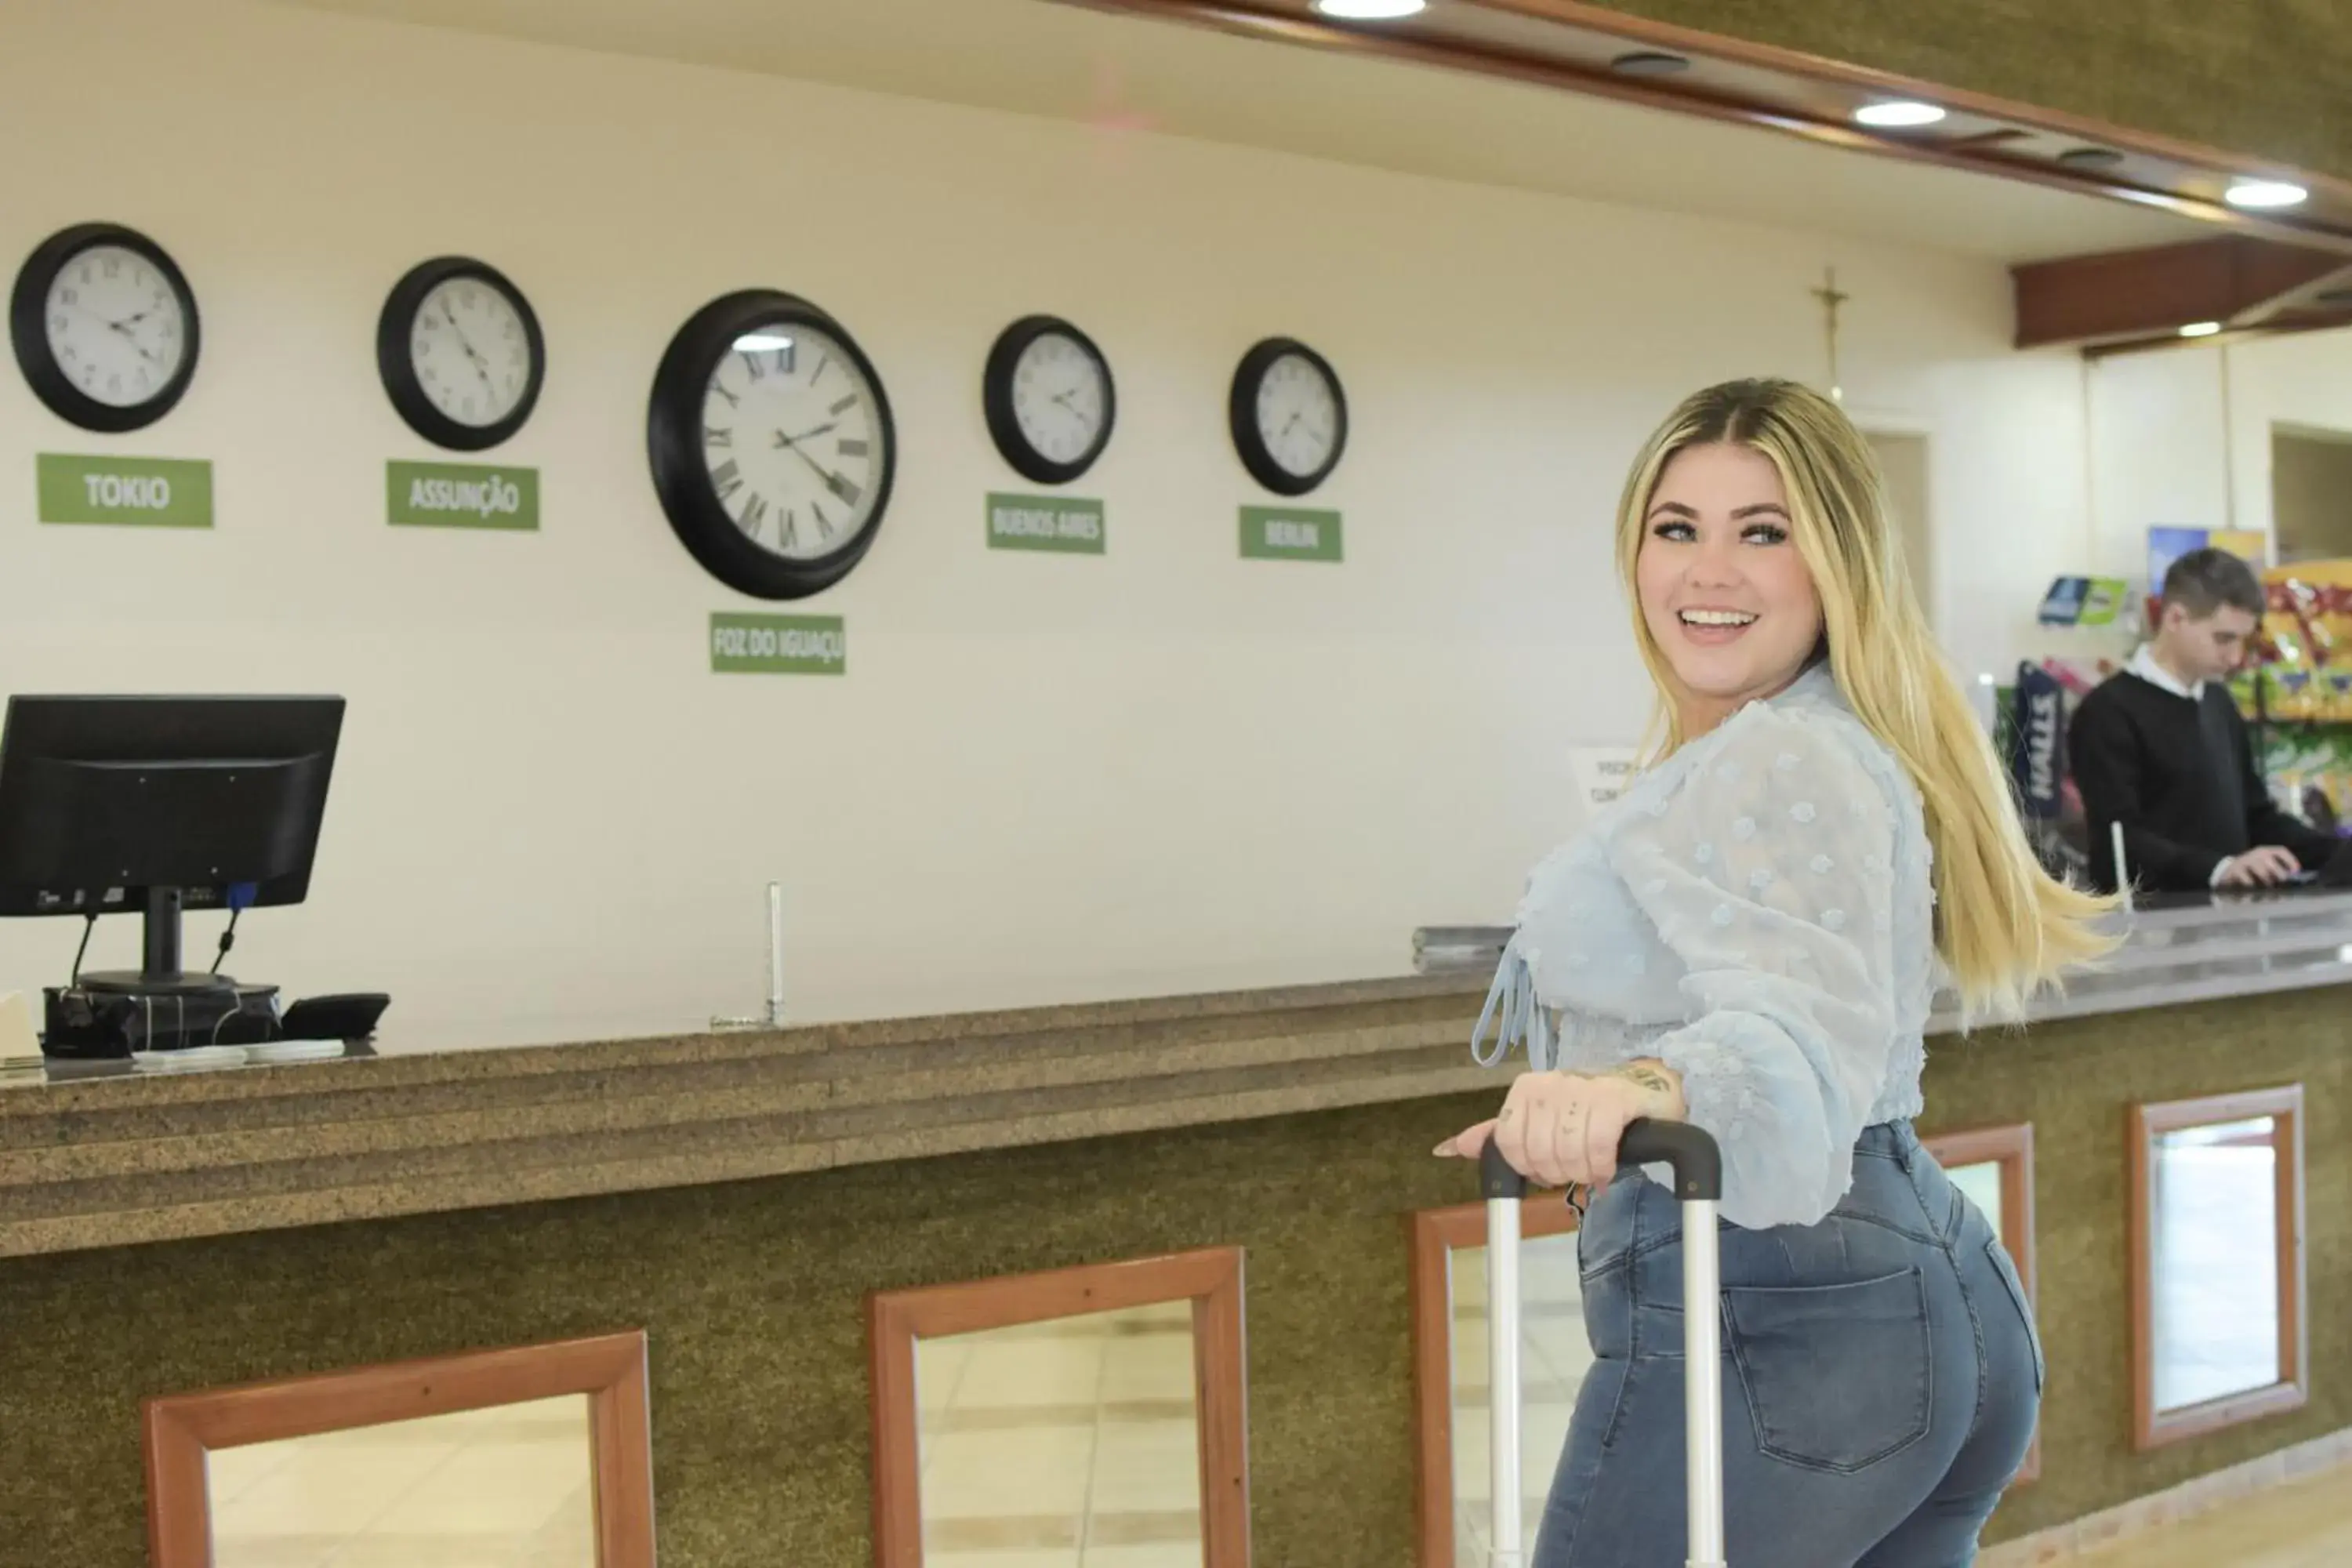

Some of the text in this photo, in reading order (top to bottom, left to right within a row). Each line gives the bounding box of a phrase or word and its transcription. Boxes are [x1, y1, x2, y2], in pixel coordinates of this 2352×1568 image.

[82, 473, 171, 510] TOKIO
[409, 474, 519, 519] ASSUNÇÃO
[993, 507, 1055, 539] BUENOS
[714, 627, 844, 664] FOZ DO IGUAÇU
[2030, 692, 2057, 800] HALLS
